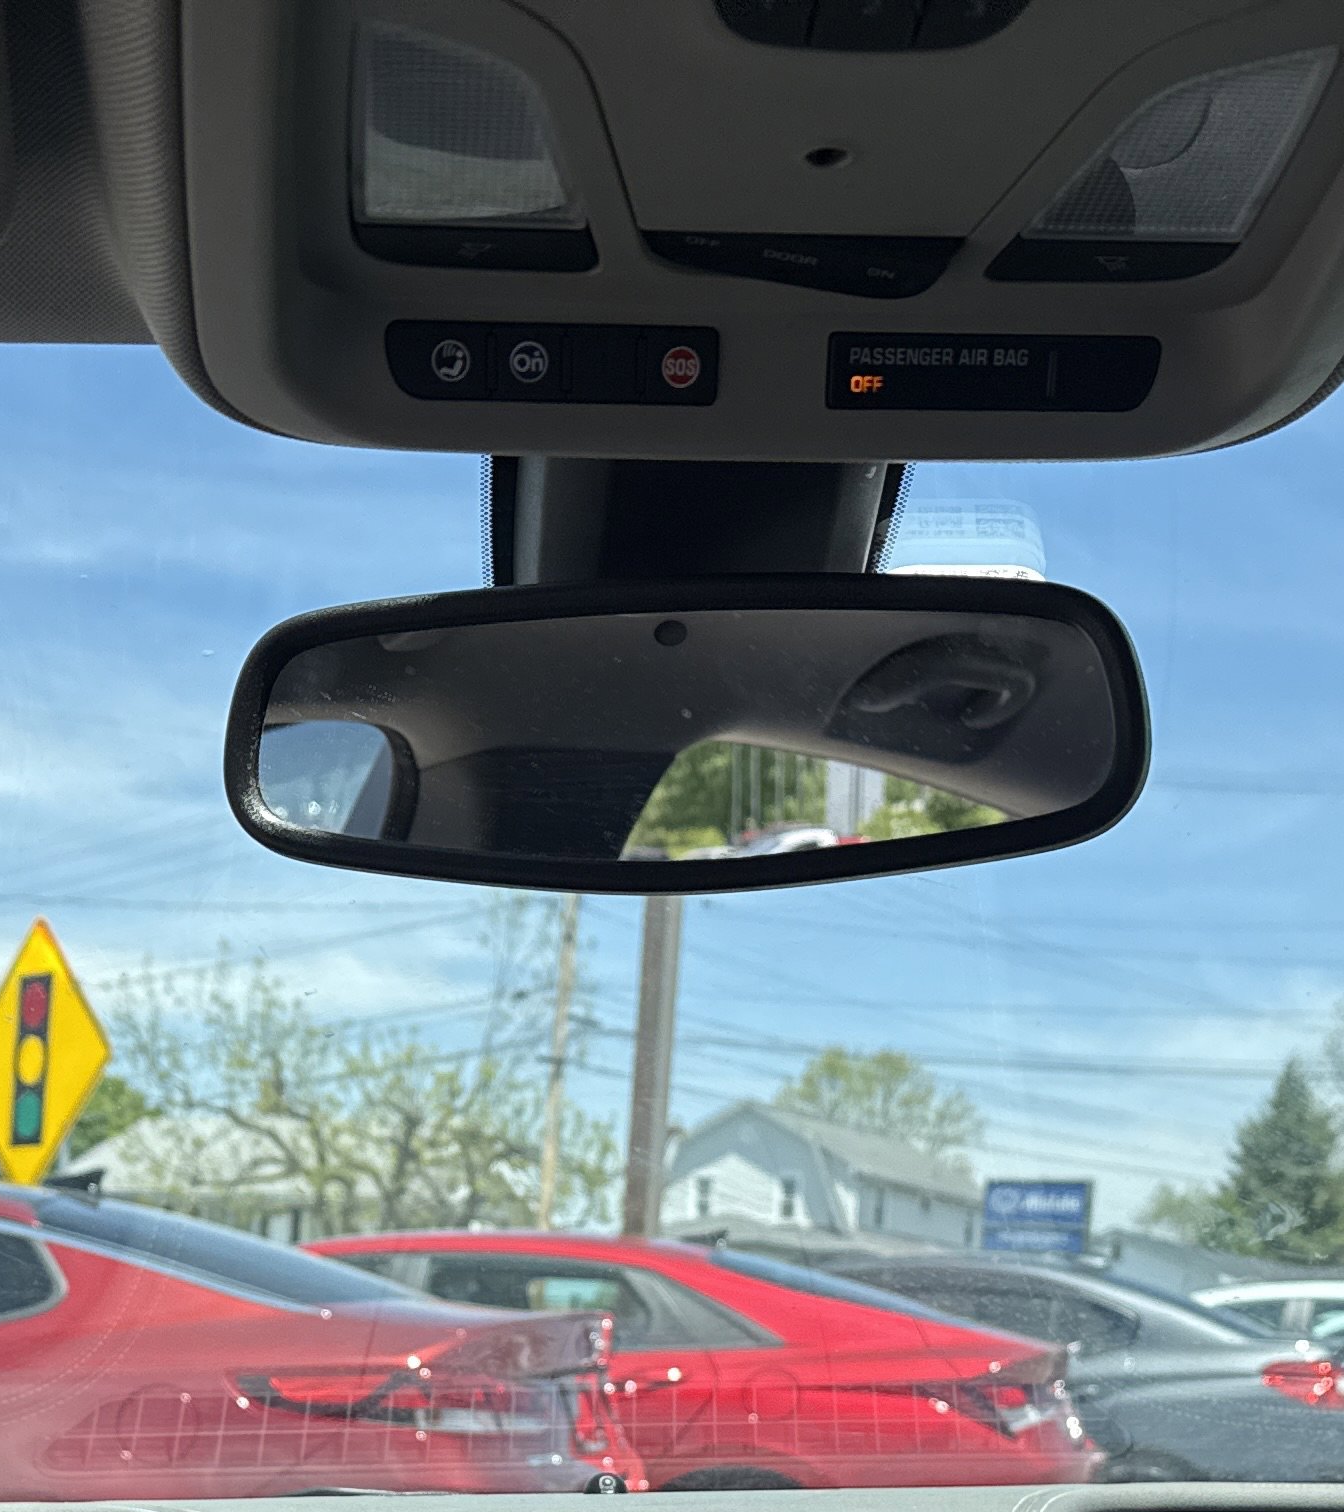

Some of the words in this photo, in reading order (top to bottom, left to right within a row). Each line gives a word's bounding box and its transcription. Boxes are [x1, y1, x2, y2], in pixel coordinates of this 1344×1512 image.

[763, 248, 819, 266] DOOR
[866, 267, 897, 280] ON
[848, 347, 954, 366] PASSENGER
[959, 348, 988, 366] AIR
[993, 349, 1029, 367] BAG
[665, 357, 695, 377] SOS
[849, 375, 885, 393] OFF
